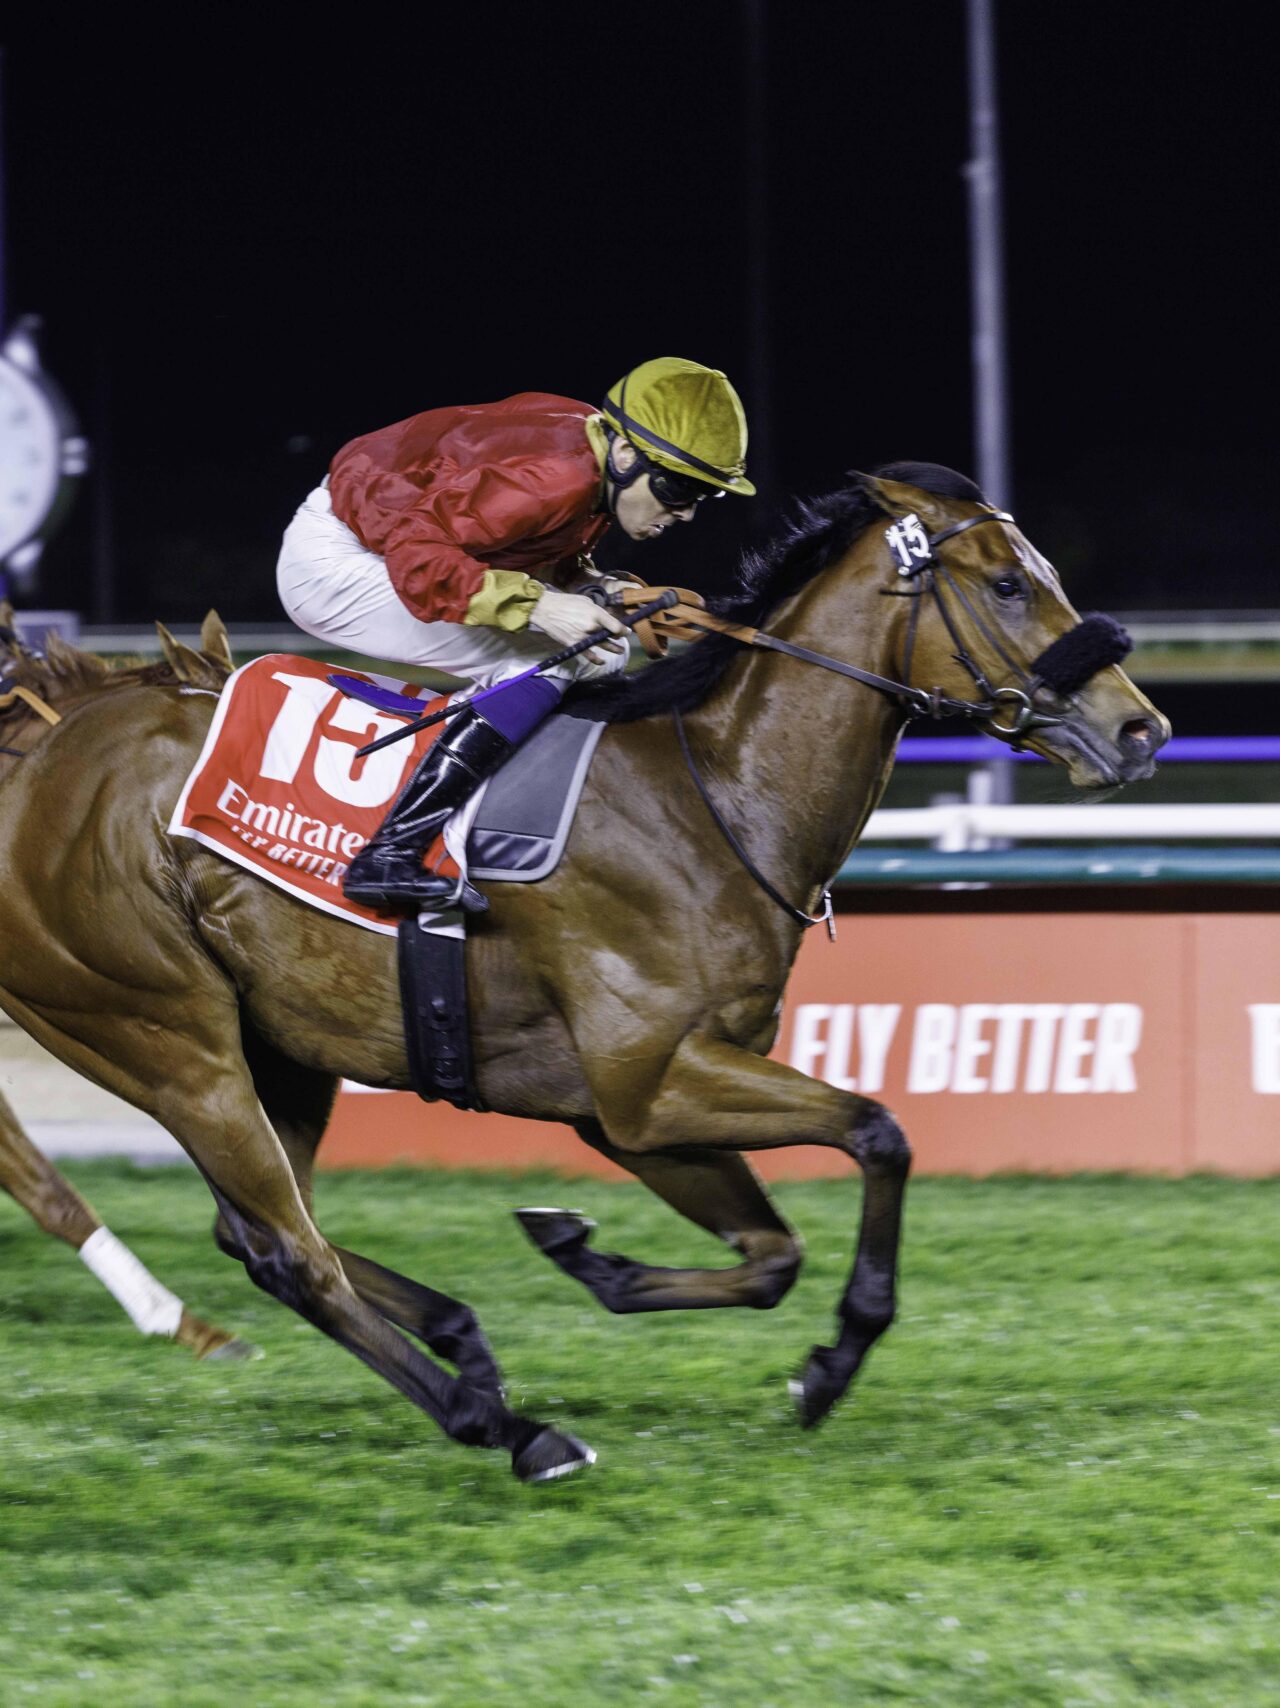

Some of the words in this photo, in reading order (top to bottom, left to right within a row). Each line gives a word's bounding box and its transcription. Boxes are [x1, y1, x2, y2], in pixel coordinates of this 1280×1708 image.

[885, 513, 932, 566] 15
[216, 778, 371, 860] Emirate
[267, 843, 349, 887] BETTER
[790, 1002, 902, 1094] FLY
[906, 1002, 1144, 1094] BETTER
